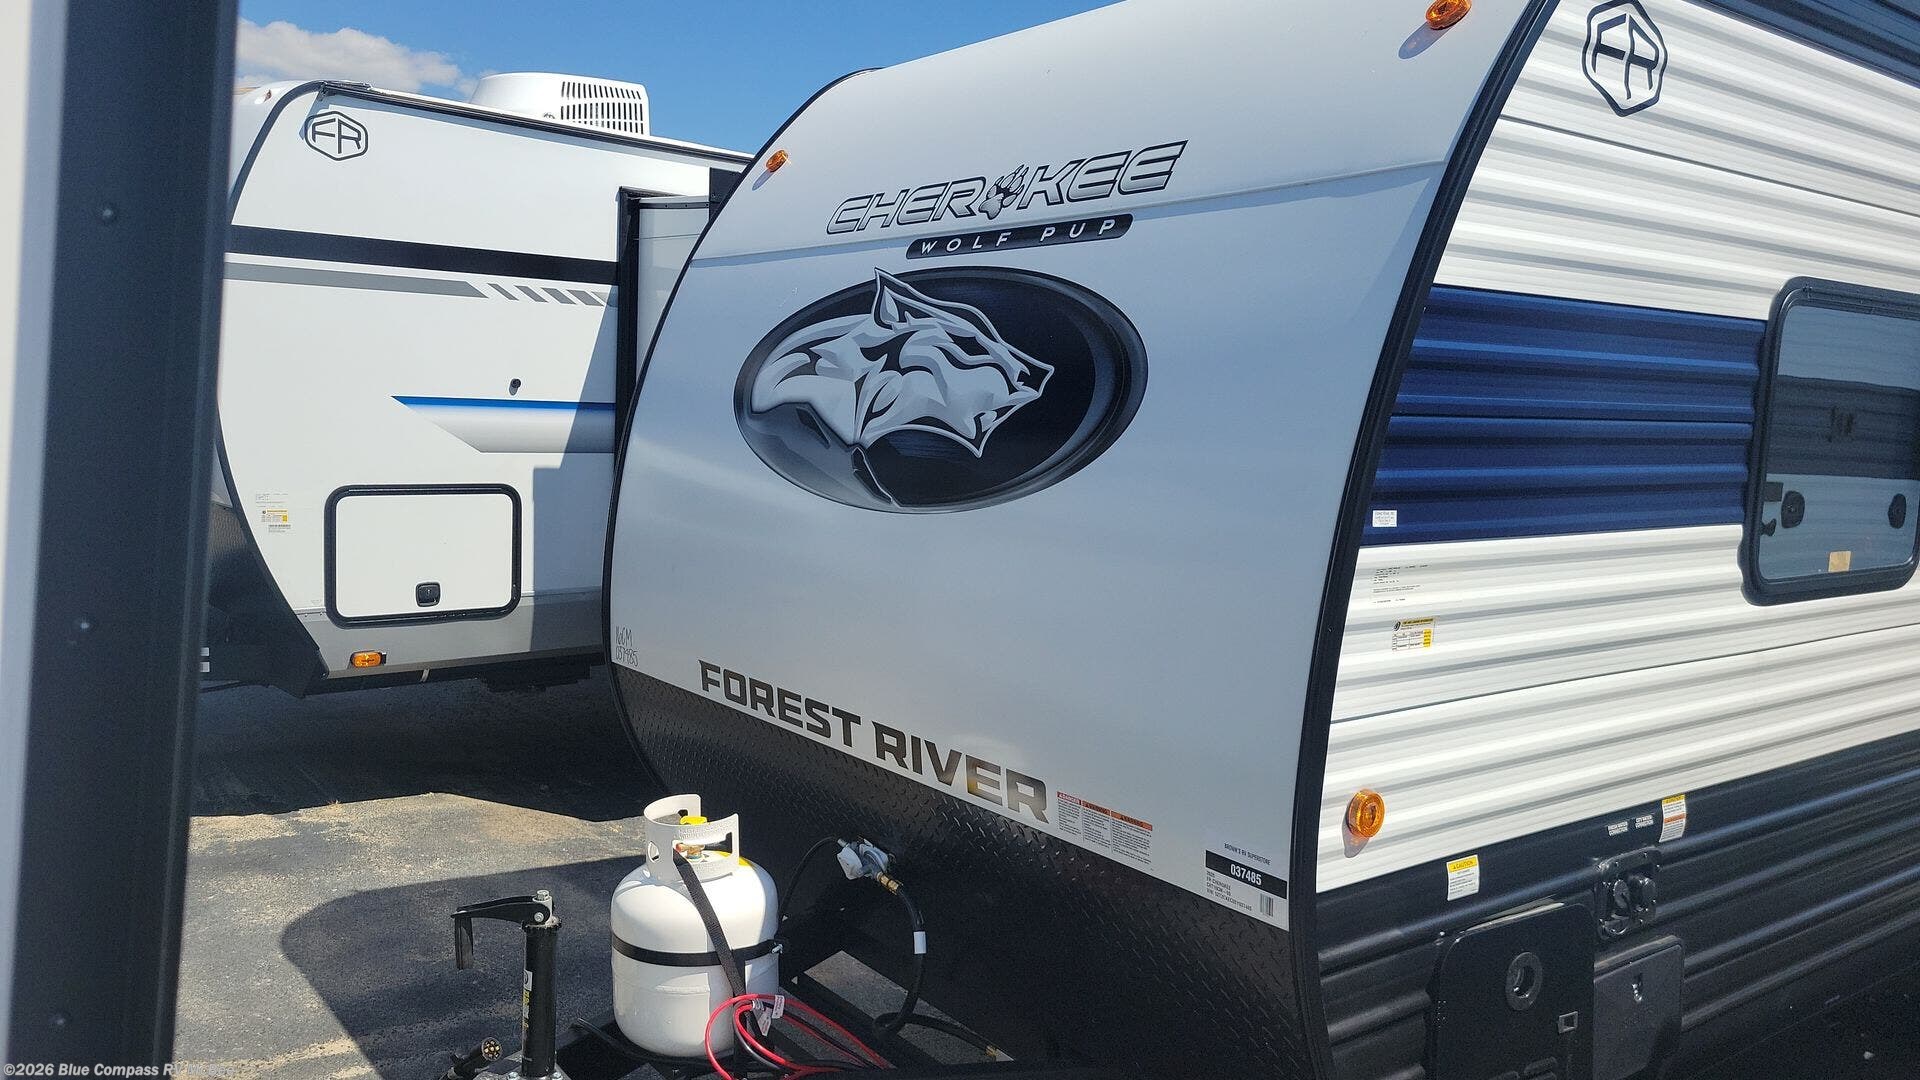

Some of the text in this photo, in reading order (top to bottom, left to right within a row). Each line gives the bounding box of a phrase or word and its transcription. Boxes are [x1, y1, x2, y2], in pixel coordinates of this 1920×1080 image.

[920, 219, 1116, 256] WOLF PUP
[698, 659, 1050, 824] FOREST RIVER
[1230, 863, 1262, 886] 037485
